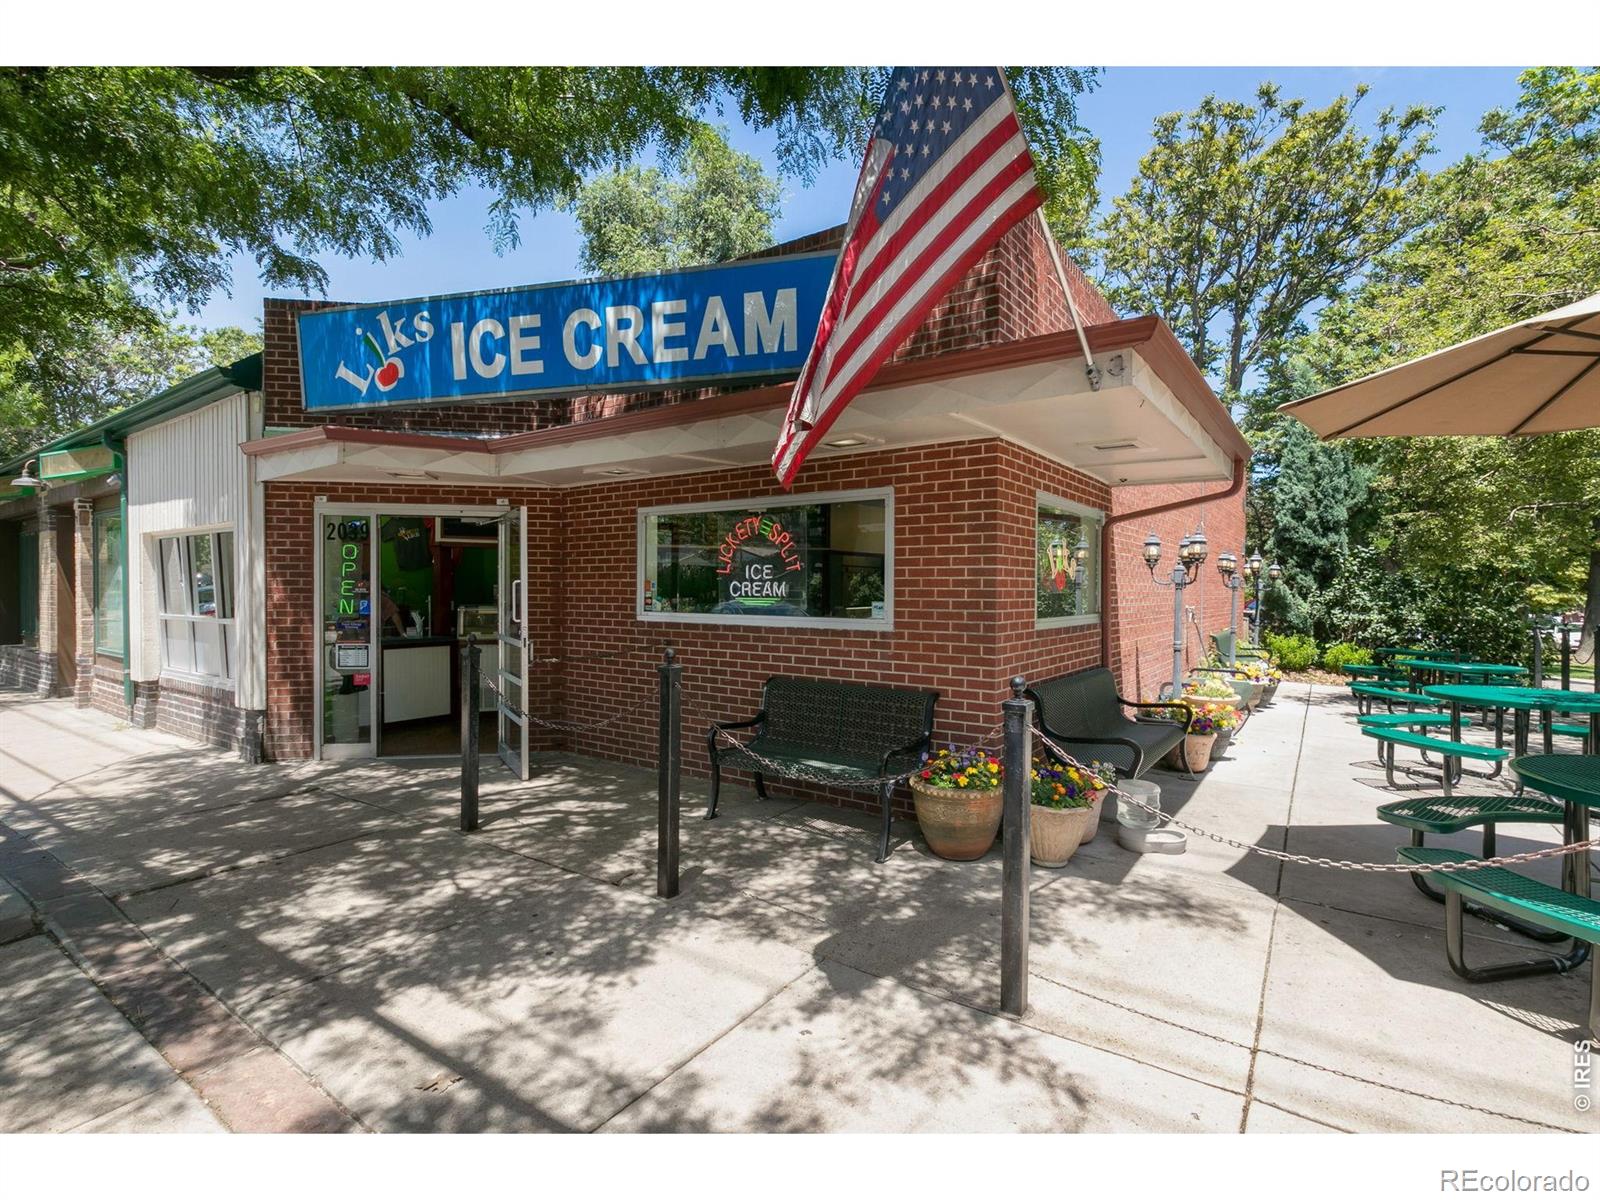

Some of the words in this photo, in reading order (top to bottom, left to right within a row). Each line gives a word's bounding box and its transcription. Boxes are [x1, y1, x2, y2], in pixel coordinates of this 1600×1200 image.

[450, 313, 544, 381] ICE
[562, 287, 798, 370] CREAM
[745, 563, 773, 579] ICE
[768, 522, 801, 571] SPLIT
[339, 544, 358, 615] OPEN
[729, 580, 786, 597] CREAM
